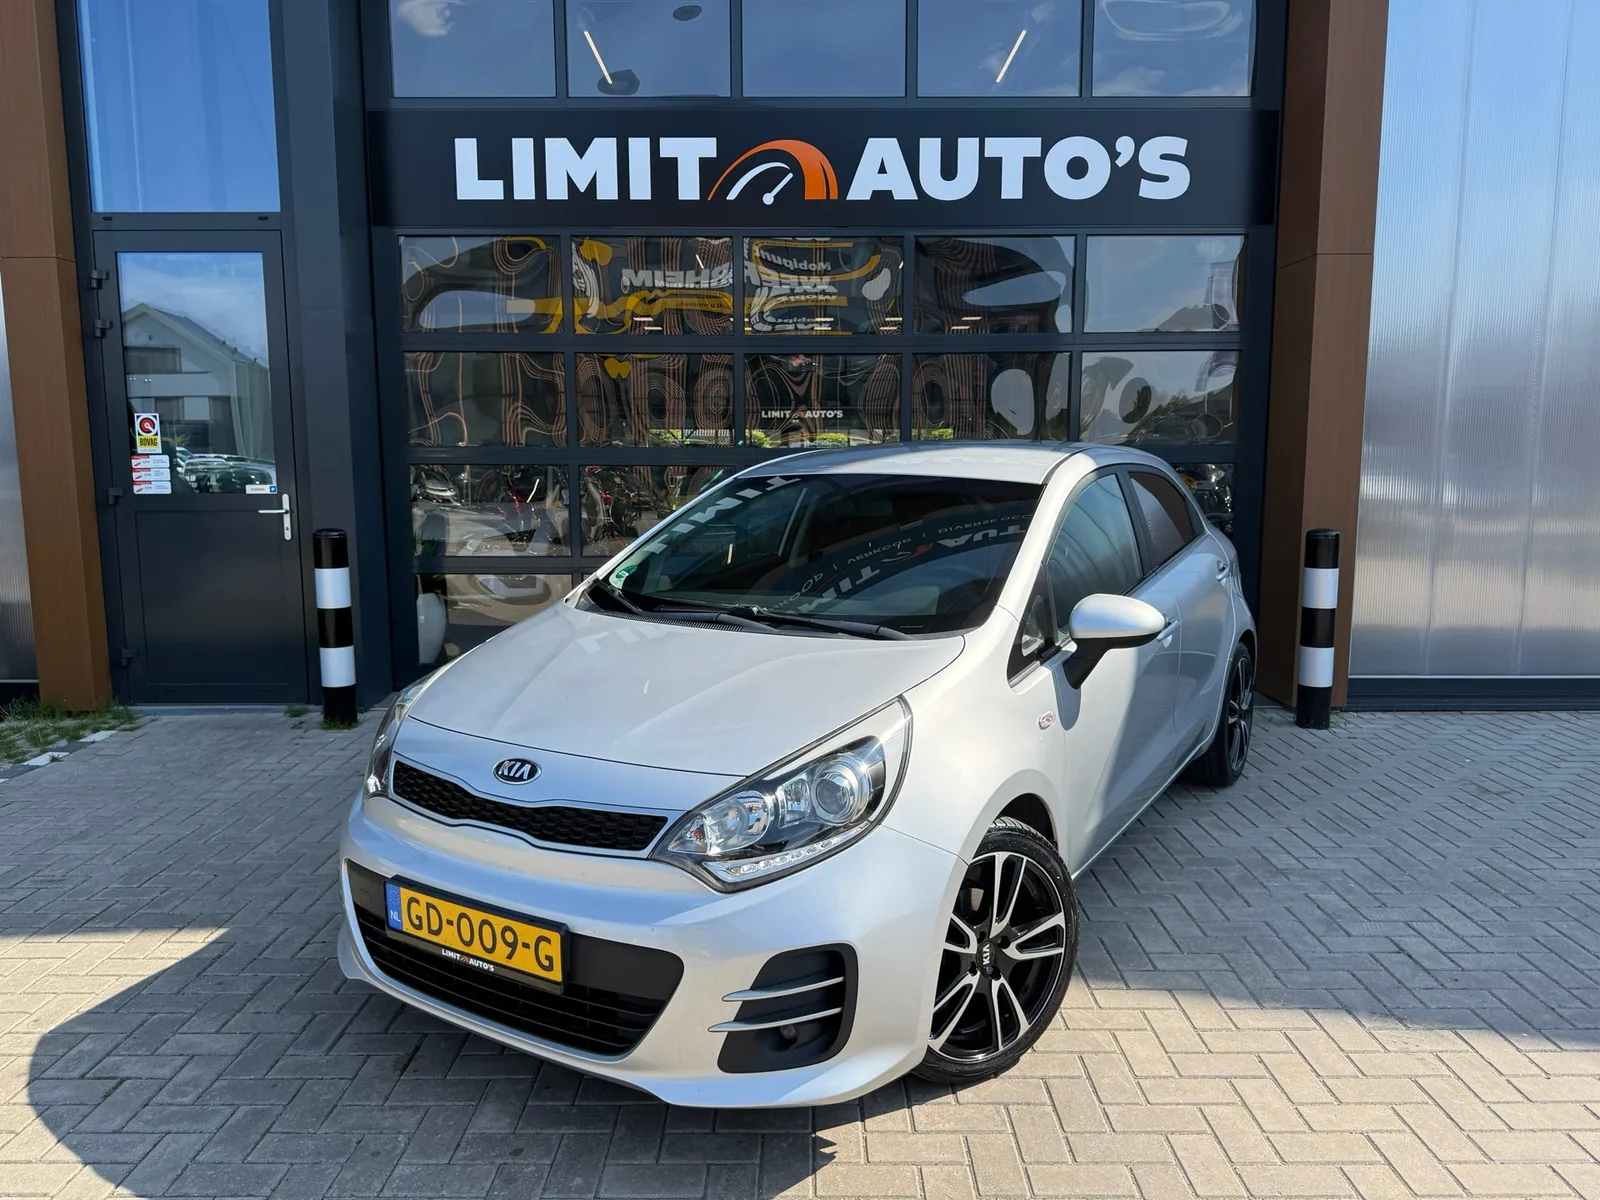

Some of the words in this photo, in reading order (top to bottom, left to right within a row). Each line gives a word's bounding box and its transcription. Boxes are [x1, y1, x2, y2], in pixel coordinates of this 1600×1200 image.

[454, 137, 717, 201] LIMIT
[846, 136, 1191, 201] AUTO'S
[762, 410, 791, 418] LIMIT
[805, 410, 843, 418] AUTO'S
[139, 437, 158, 447] BOVAG
[498, 760, 531, 780] KIA
[390, 909, 401, 922] NL
[406, 896, 554, 972] GD-009-G
[441, 949, 460, 961] LIMIT
[469, 957, 494, 972] AUTO'S
[982, 943, 990, 966] KIA
